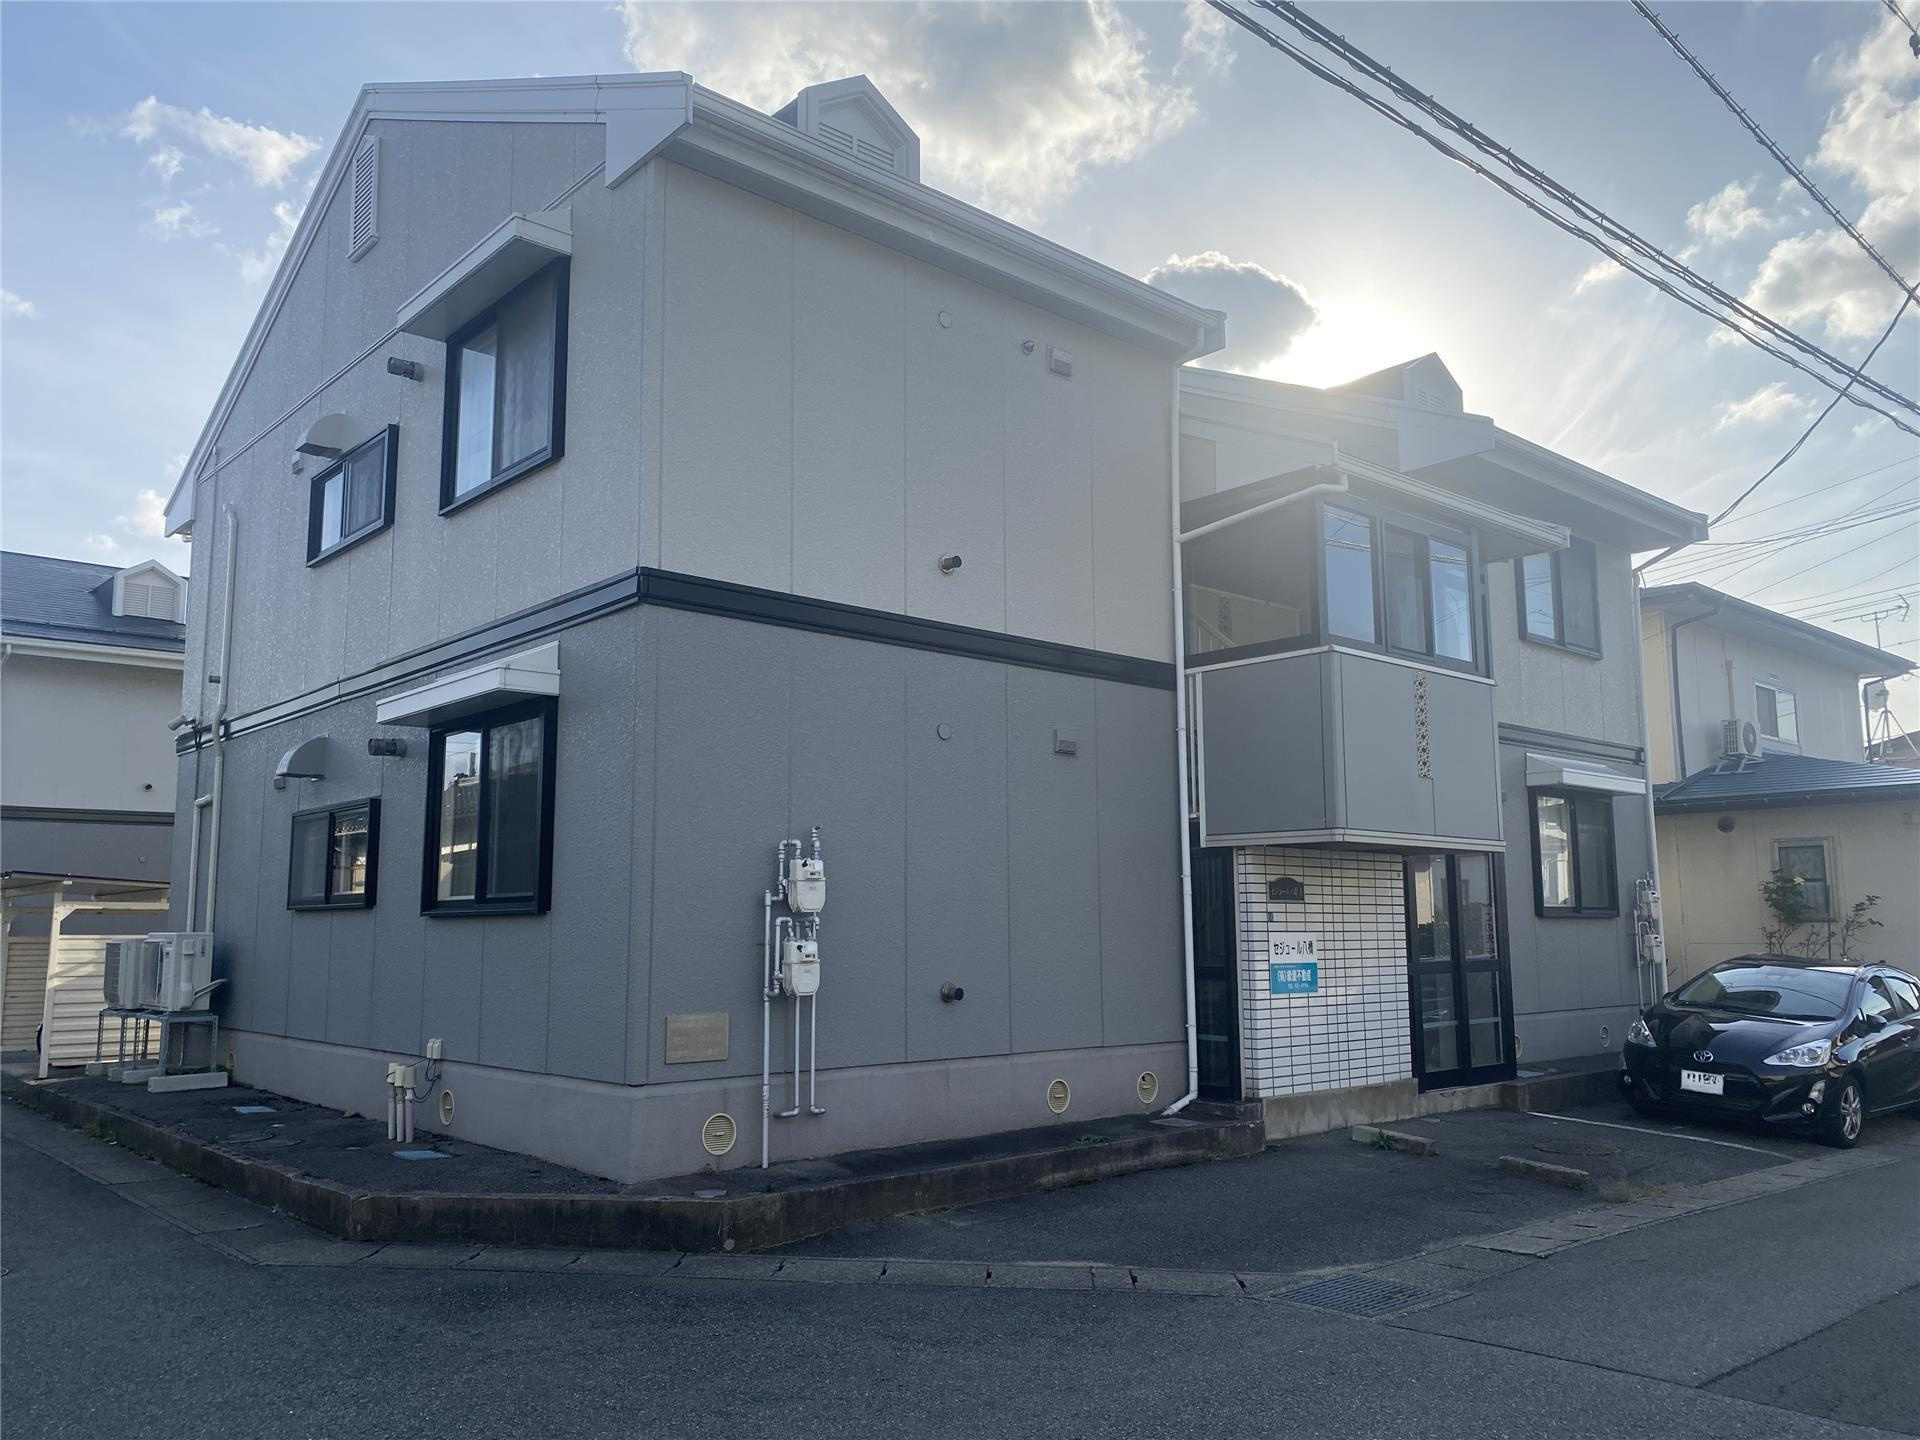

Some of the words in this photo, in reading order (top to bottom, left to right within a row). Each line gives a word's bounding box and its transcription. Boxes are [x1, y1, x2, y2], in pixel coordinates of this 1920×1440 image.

[1273, 940, 1314, 956] セジュール八橋
